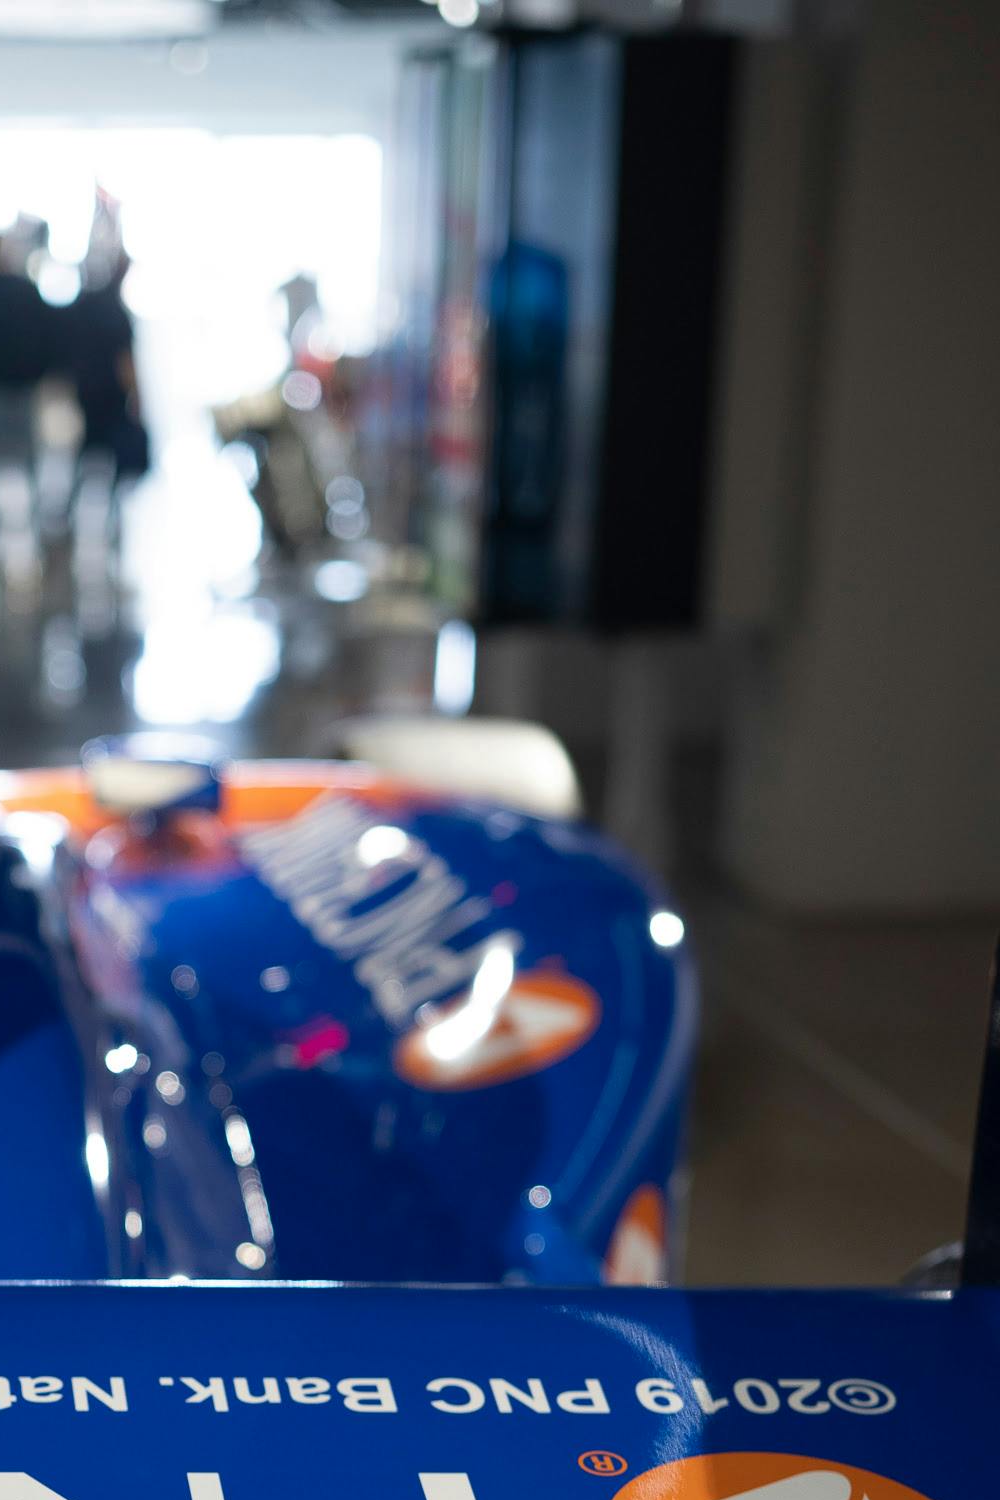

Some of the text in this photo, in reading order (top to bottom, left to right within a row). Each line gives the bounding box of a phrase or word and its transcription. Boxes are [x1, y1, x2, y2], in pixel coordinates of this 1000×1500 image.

[158, 1375, 399, 1414] Bank.
[425, 1377, 611, 1415] PNC
[634, 1377, 897, 1415] ©2019
